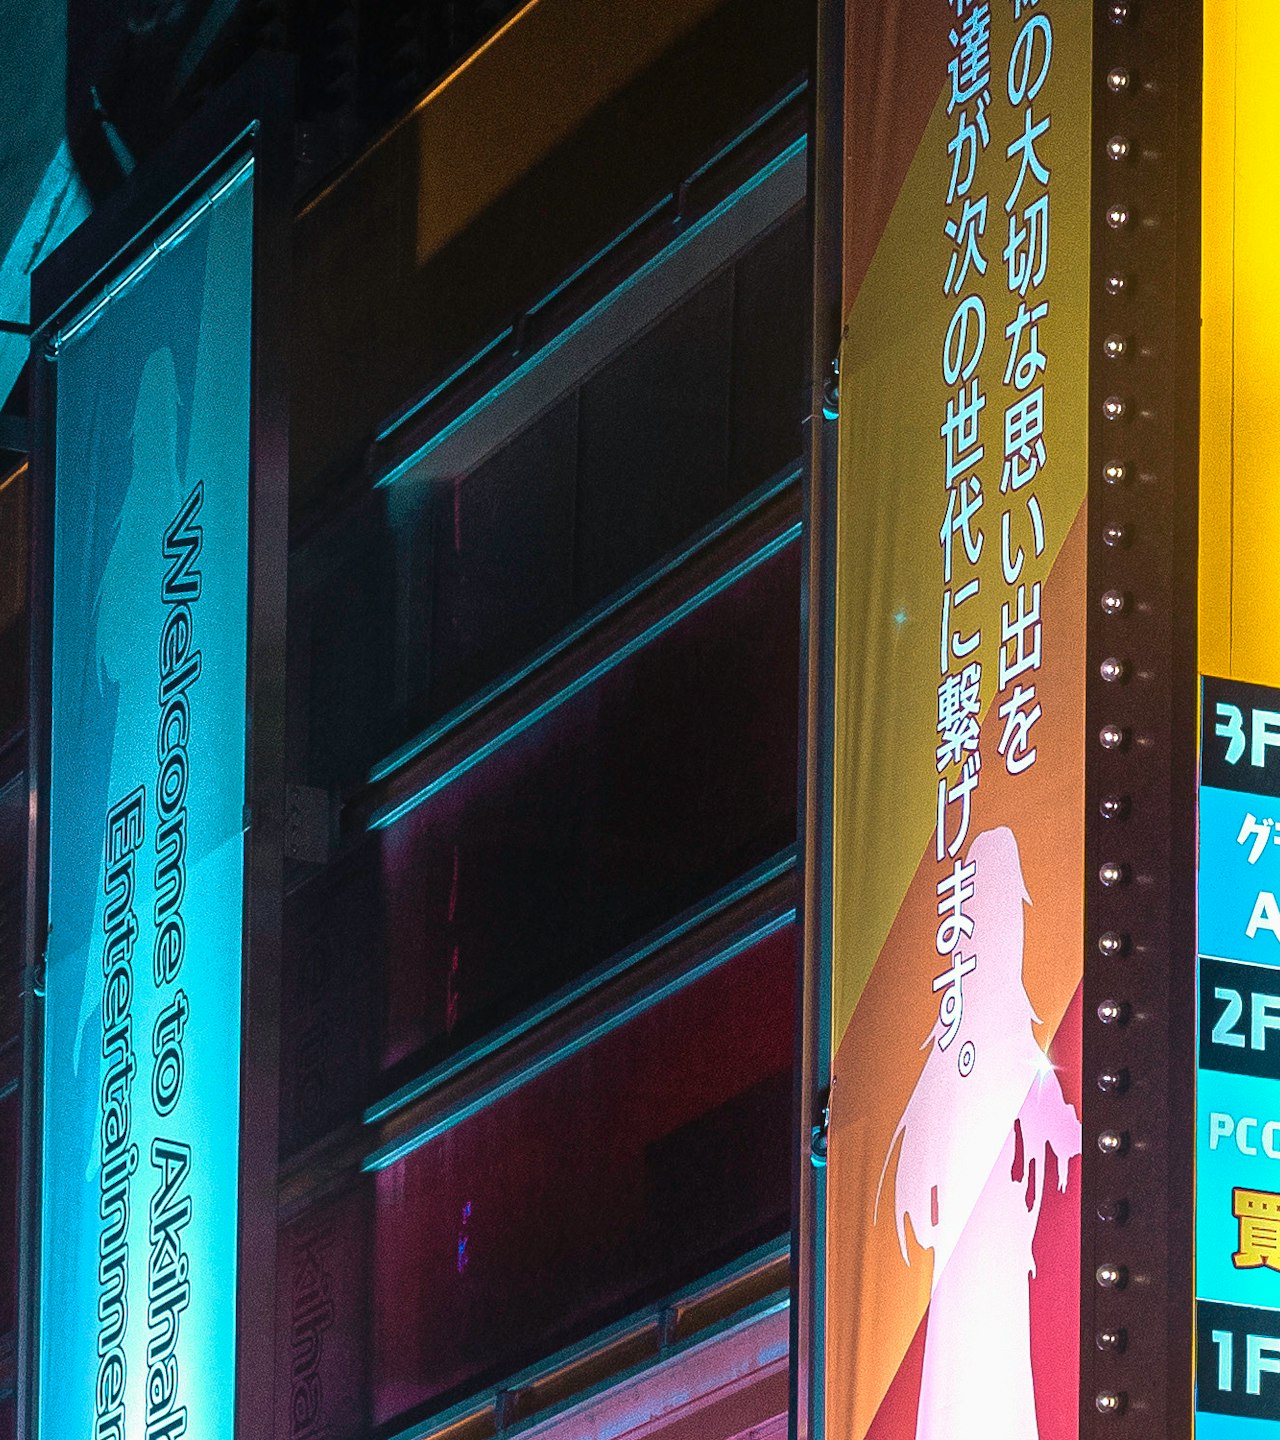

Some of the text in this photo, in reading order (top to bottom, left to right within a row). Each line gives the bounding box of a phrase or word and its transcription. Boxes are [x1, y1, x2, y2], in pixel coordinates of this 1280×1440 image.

[931, 0, 993, 1076] 達が次の世代に繋げます。
[997, 0, 1054, 775] の大切な思い出を
[154, 481, 205, 985] Welcome
[151, 992, 191, 1117] to
